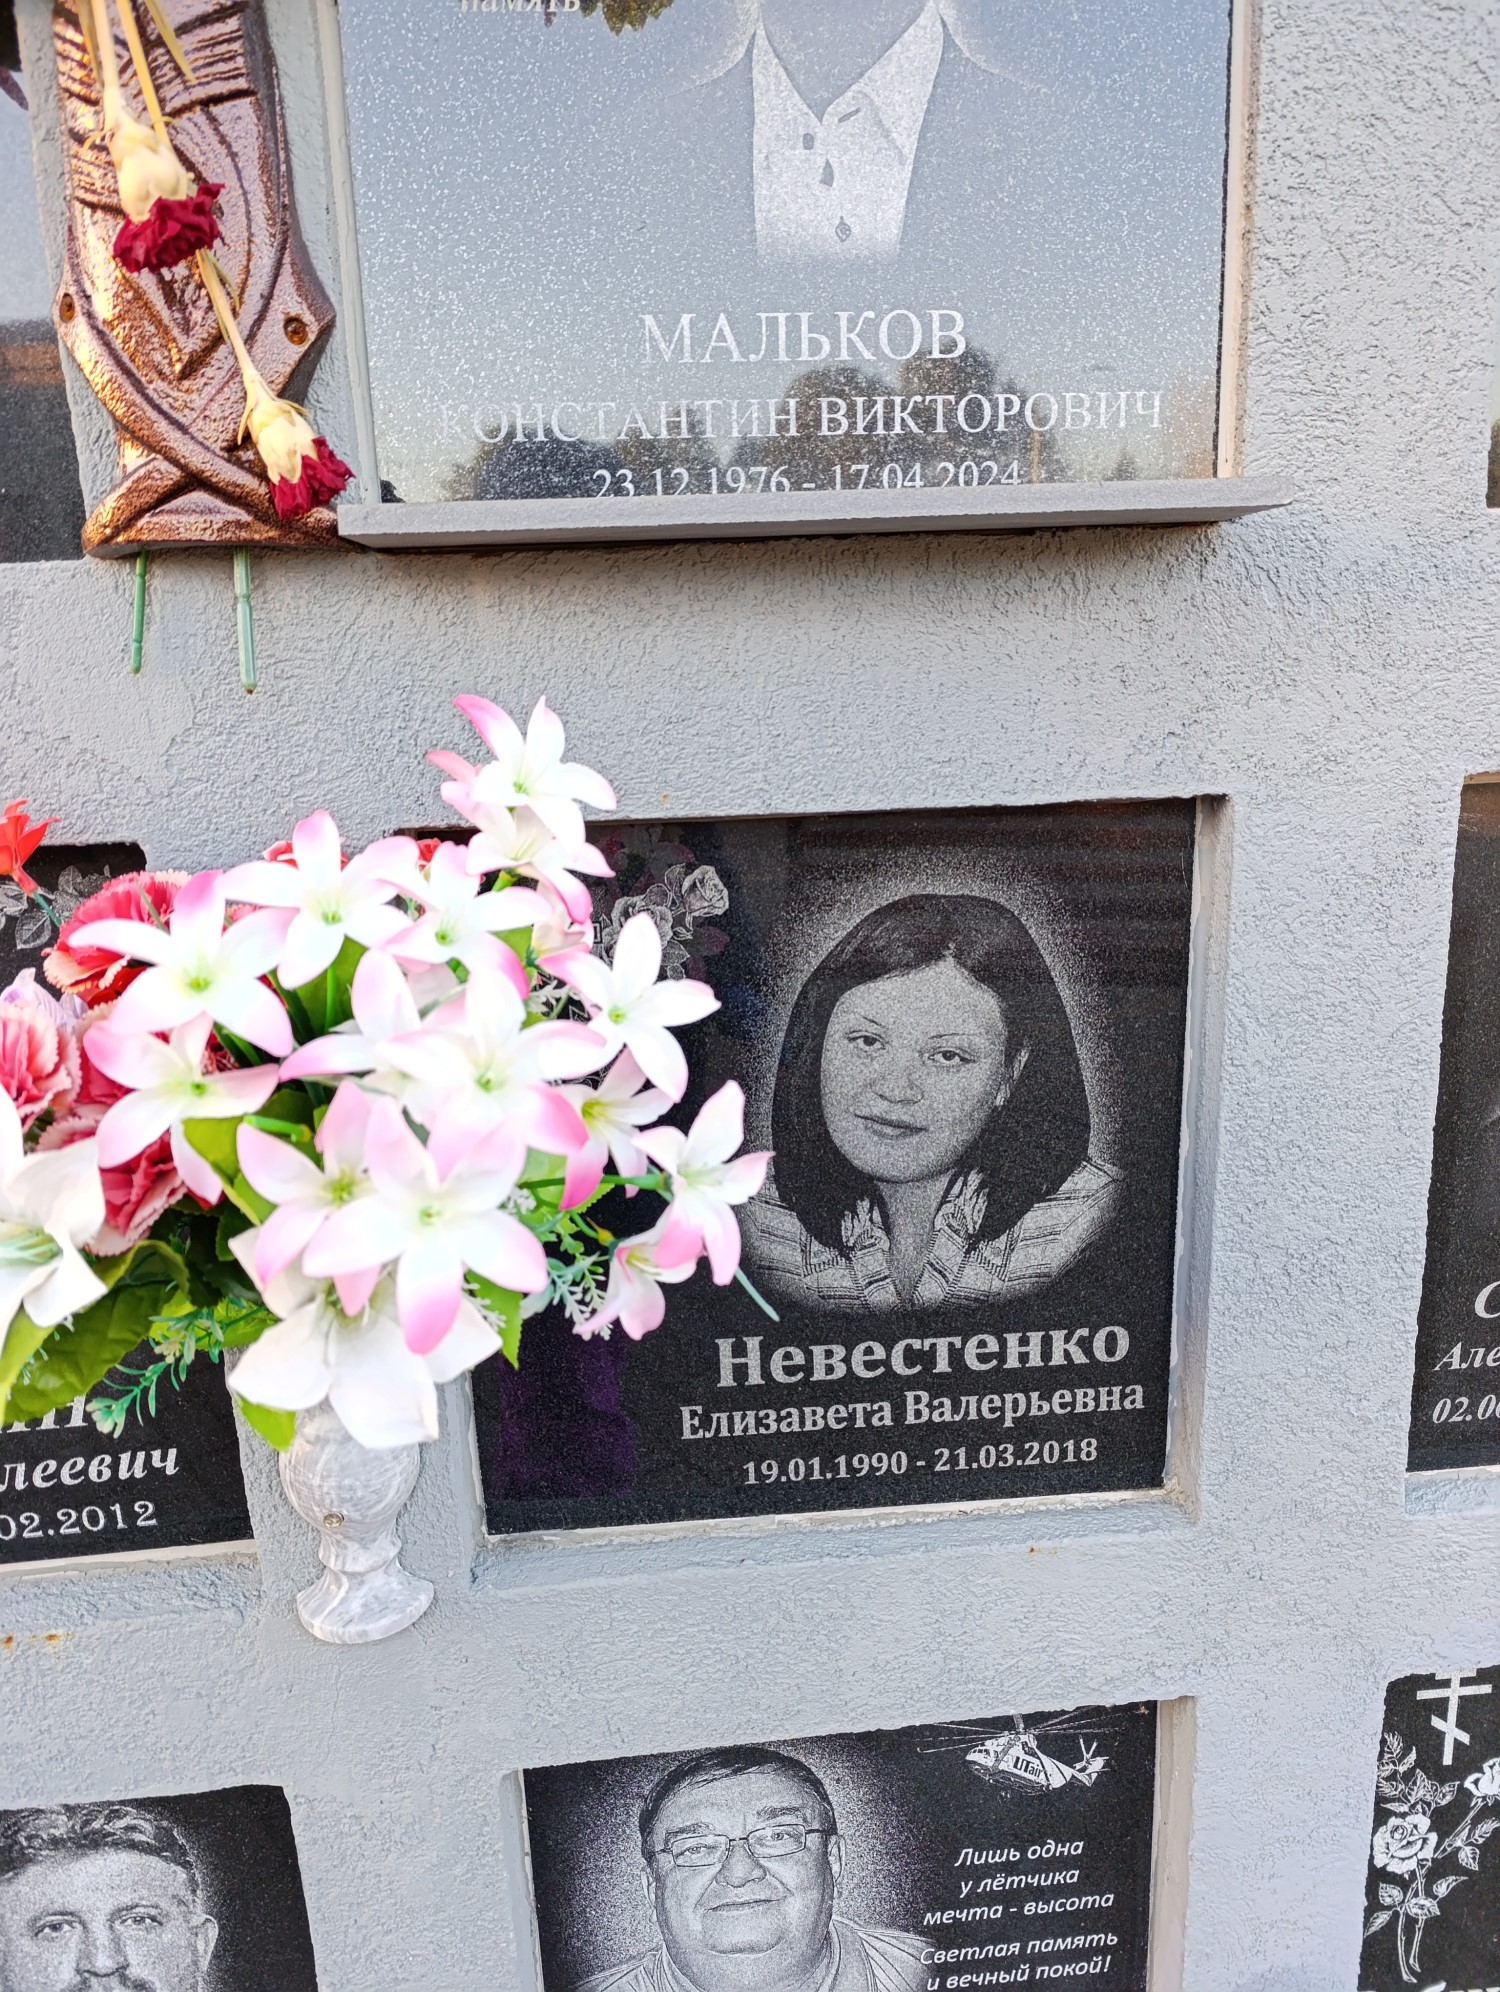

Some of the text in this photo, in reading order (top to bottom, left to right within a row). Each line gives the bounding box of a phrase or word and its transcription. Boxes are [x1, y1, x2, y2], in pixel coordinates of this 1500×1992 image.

[641, 309, 968, 364] МАЛЬКОВ
[440, 390, 1164, 443] КОНСТАНТИН ВИКТОРОВИЧ
[592, 465, 791, 499] 23121976
[831, 459, 1022, 491] 17042024
[716, 1325, 1130, 1387] Невестенко
[680, 1385, 1144, 1439] Елизавета Валерьевна
[743, 1450, 908, 1485] 19.01.1990
[933, 1437, 1099, 1473] 21.03.2018
[954, 1839, 1084, 1868] Лишь одна
[959, 1869, 1079, 1899] у лётчика
[923, 1902, 1003, 1926] мечта
[1024, 1893, 1114, 1915] высота
[920, 1933, 1118, 1966] Светлая память
[927, 1956, 1111, 1992] и вечный покой!
